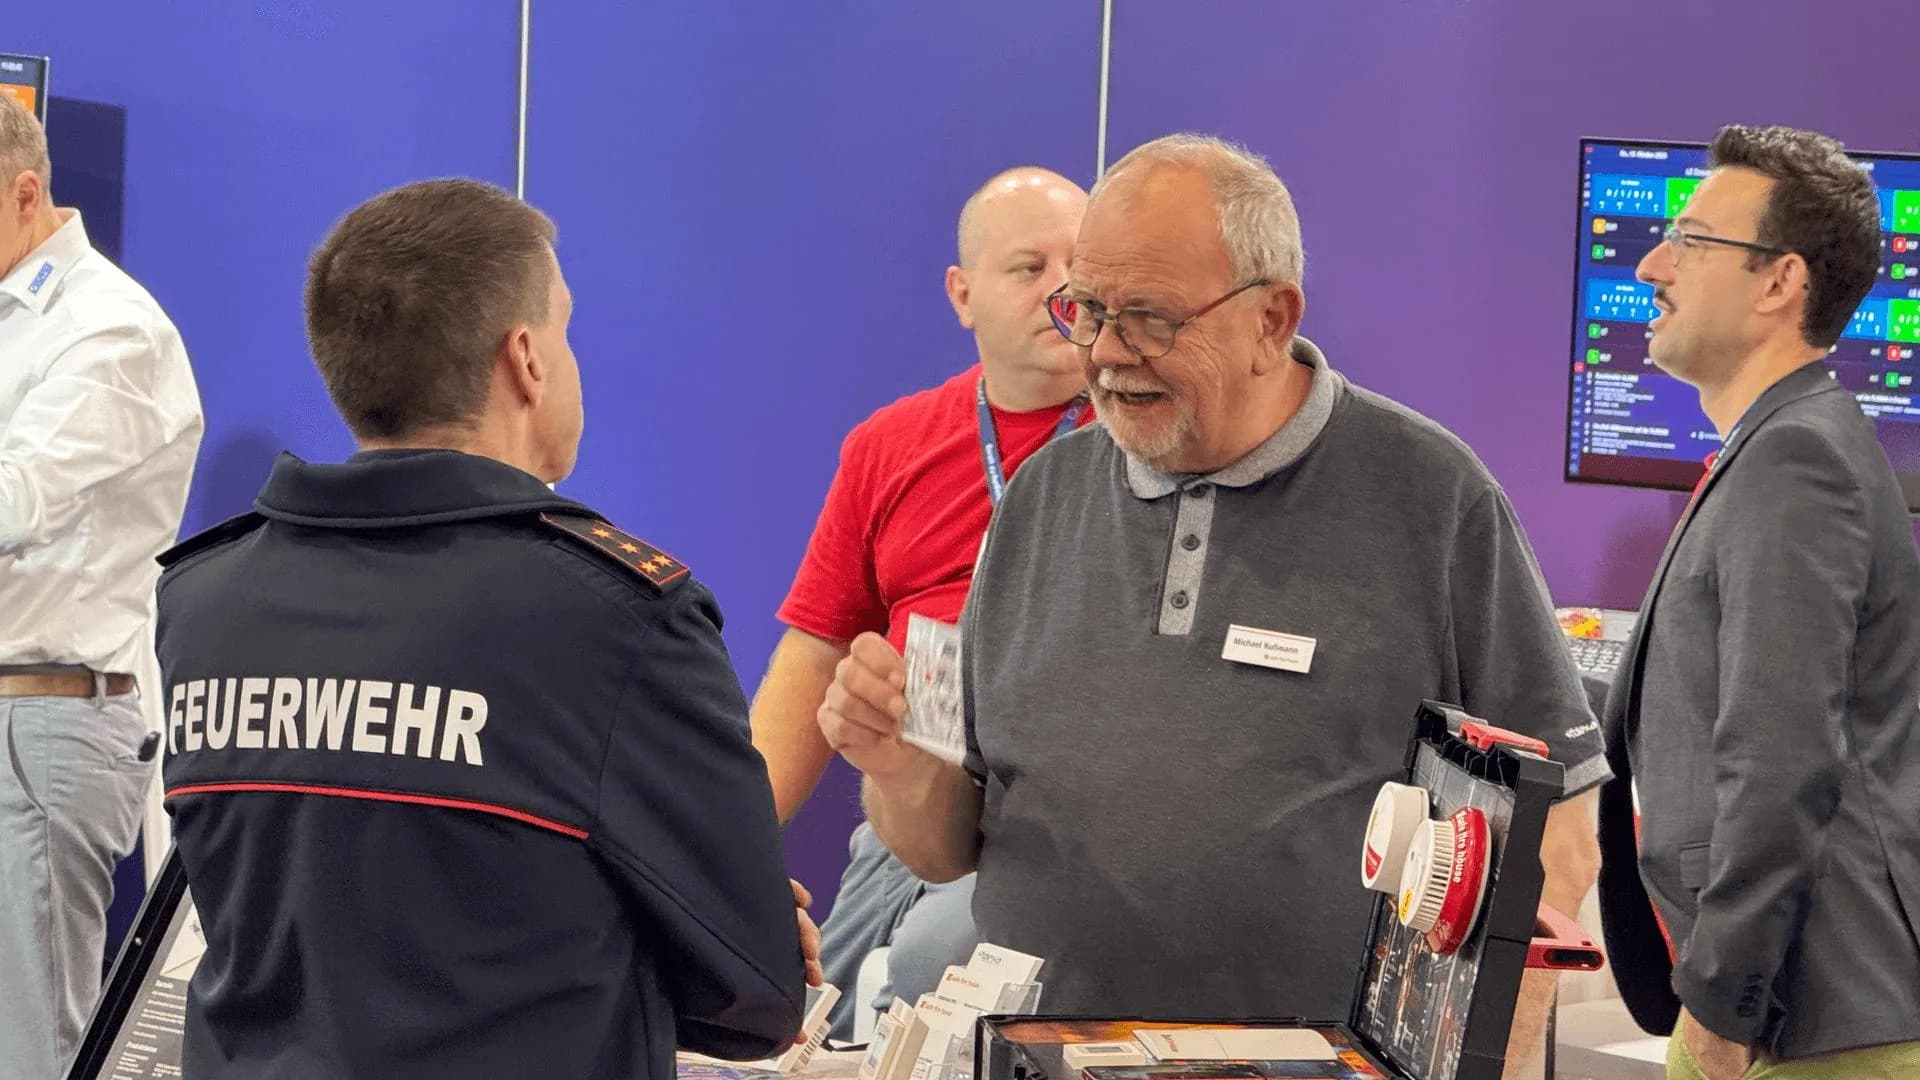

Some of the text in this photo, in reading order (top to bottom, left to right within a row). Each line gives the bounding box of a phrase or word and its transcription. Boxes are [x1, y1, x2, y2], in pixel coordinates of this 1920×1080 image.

[1233, 638, 1262, 649] Michael
[168, 677, 488, 766] FEUERWEHR
[1453, 851, 1467, 883] house
